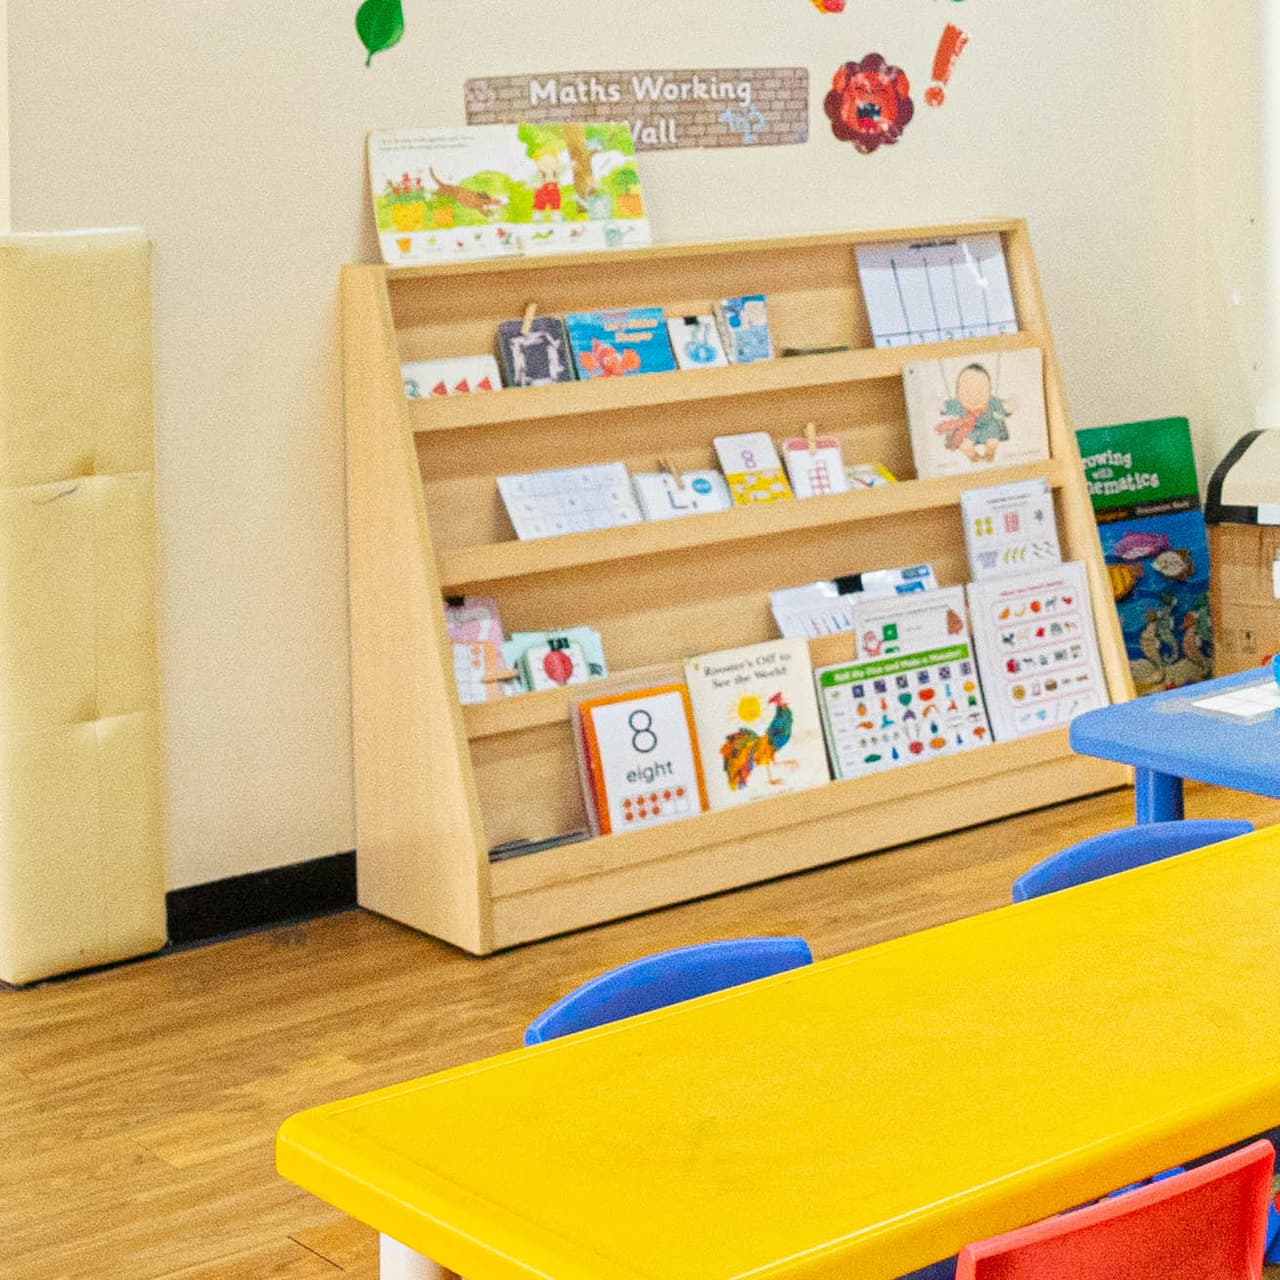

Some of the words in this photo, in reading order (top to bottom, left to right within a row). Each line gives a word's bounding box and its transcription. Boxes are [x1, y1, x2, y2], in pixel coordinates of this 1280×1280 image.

[529, 77, 621, 106] Maths
[632, 75, 752, 108] Working
[628, 709, 658, 753] 8
[626, 761, 674, 784] eight
